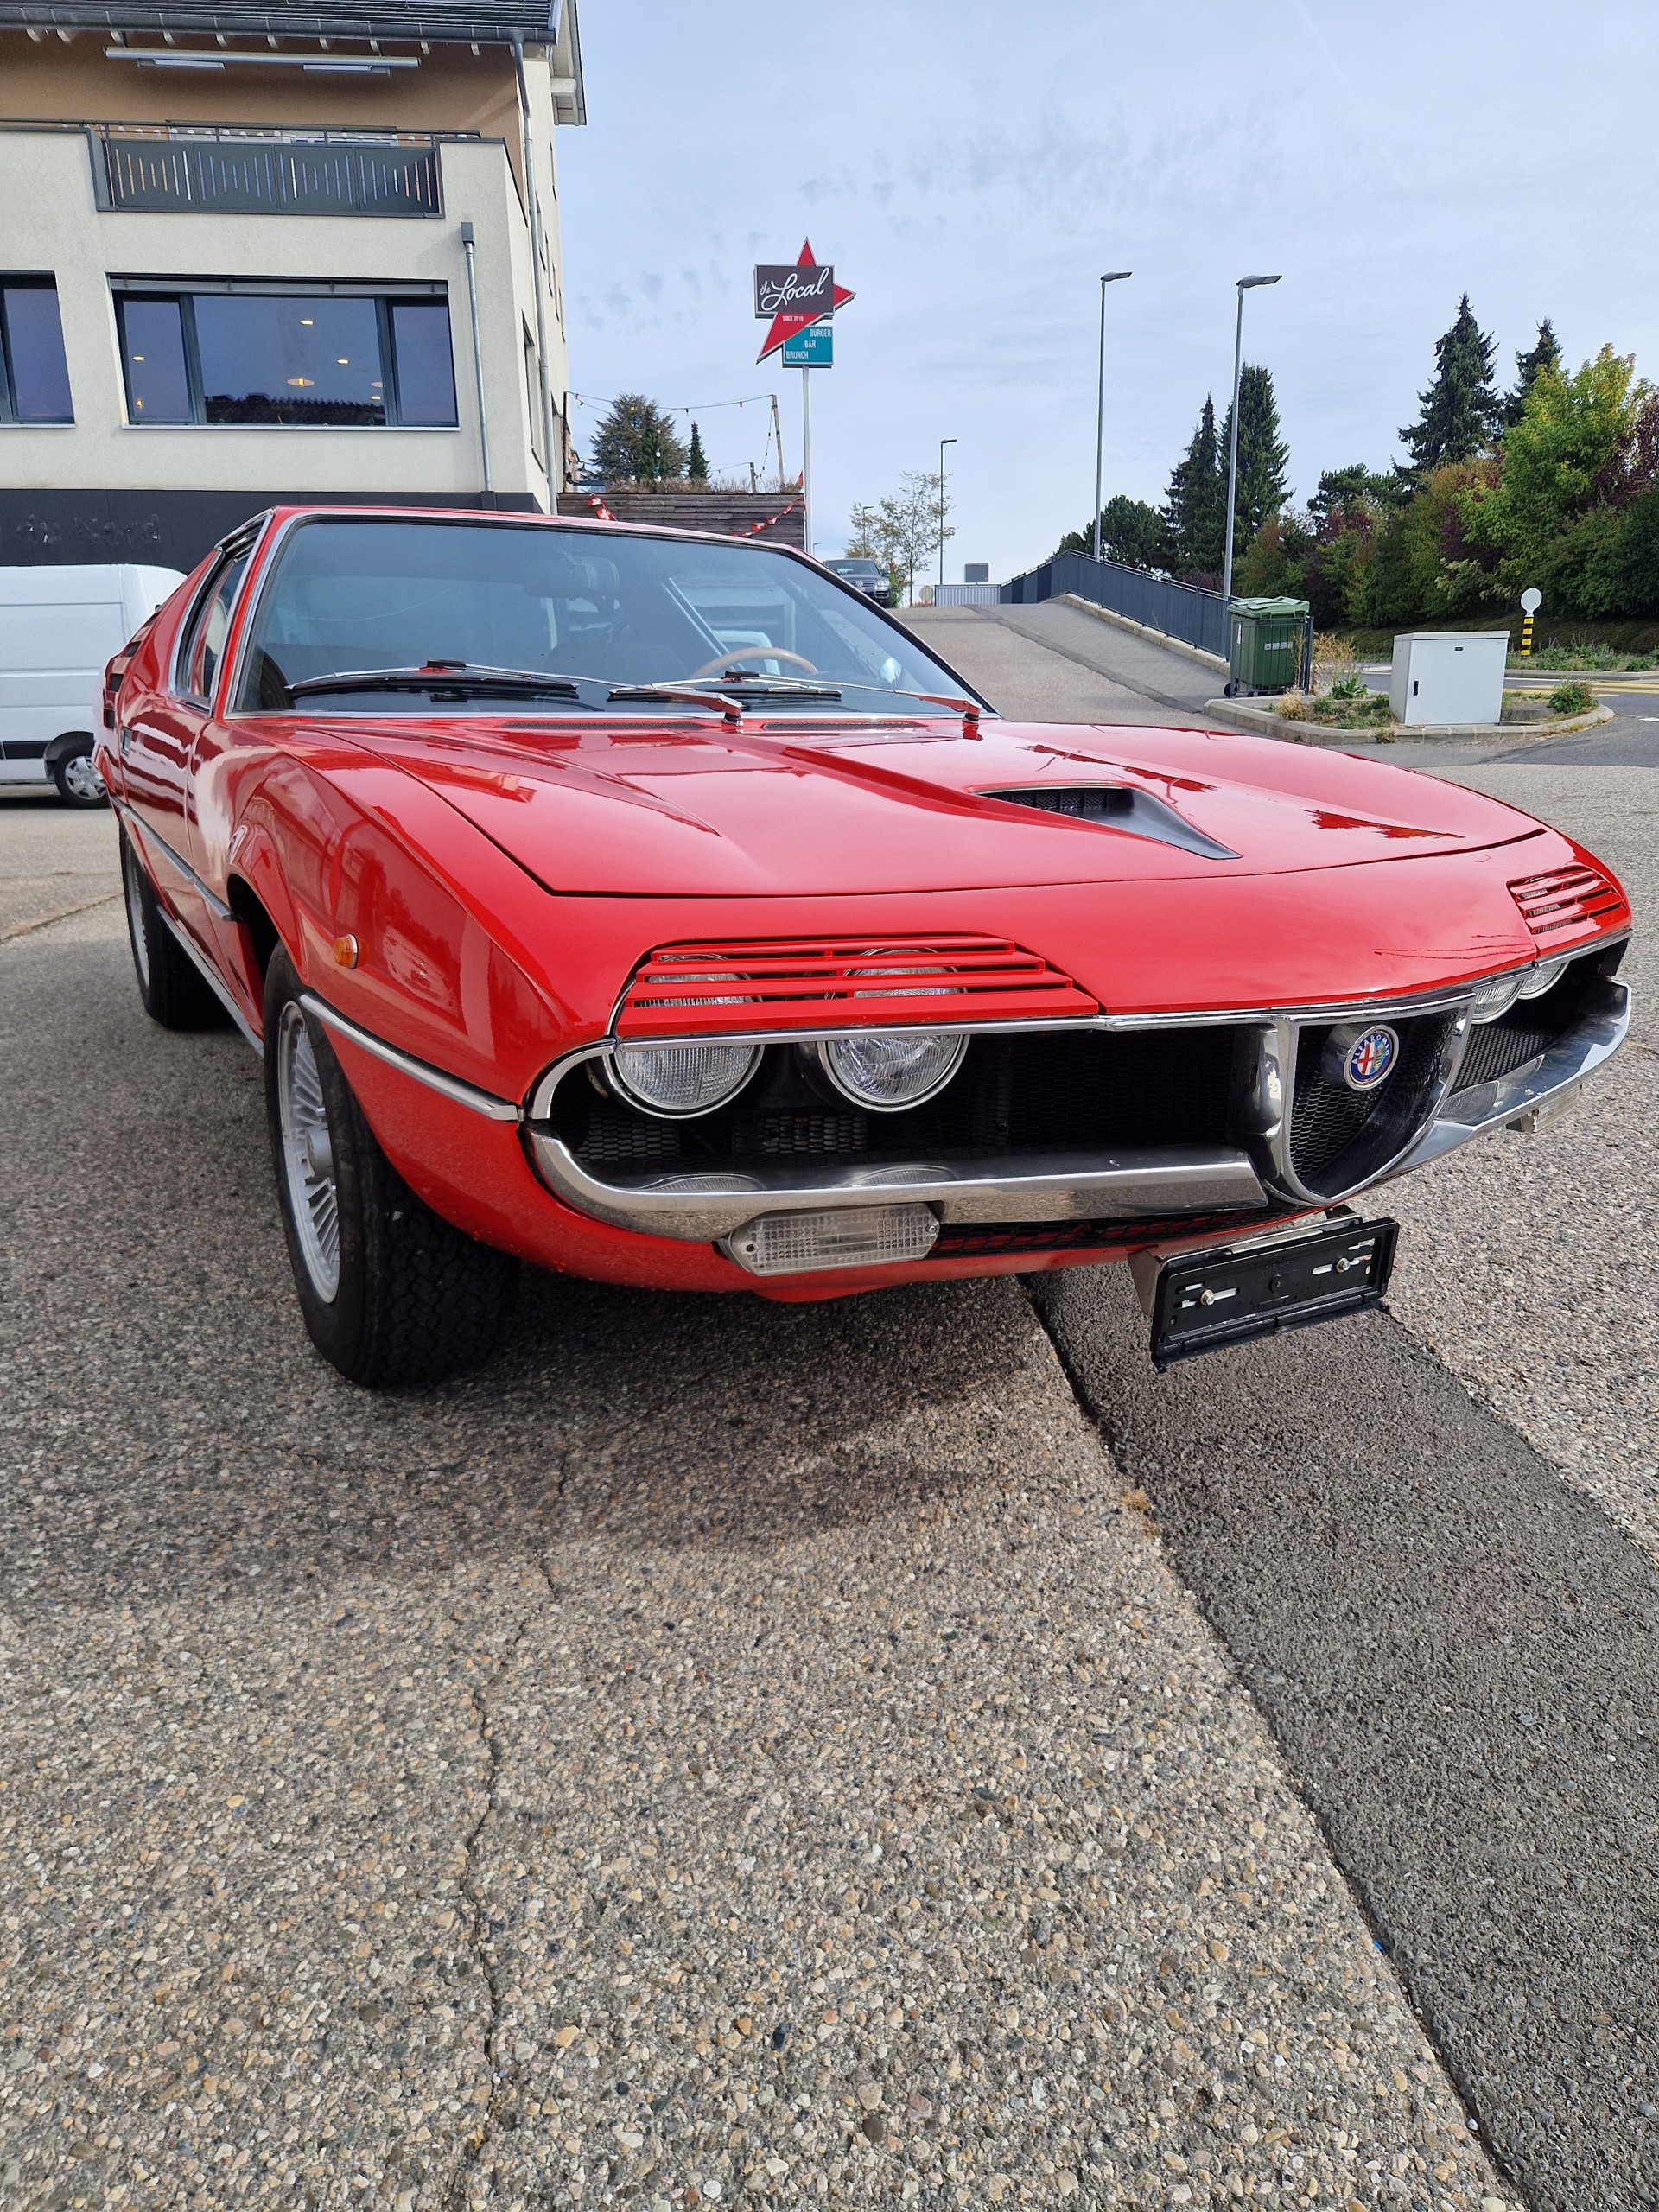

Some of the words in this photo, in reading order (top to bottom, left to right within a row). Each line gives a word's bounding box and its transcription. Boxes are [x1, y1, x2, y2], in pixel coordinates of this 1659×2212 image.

[760, 281, 771, 296] the
[761, 267, 830, 311] Local
[810, 328, 831, 337] BURGER
[804, 340, 816, 348] BAR
[786, 351, 809, 359] BRUNCH
[1351, 1039, 1370, 1065] ALFA
[1370, 1034, 1390, 1057] ROMEO
